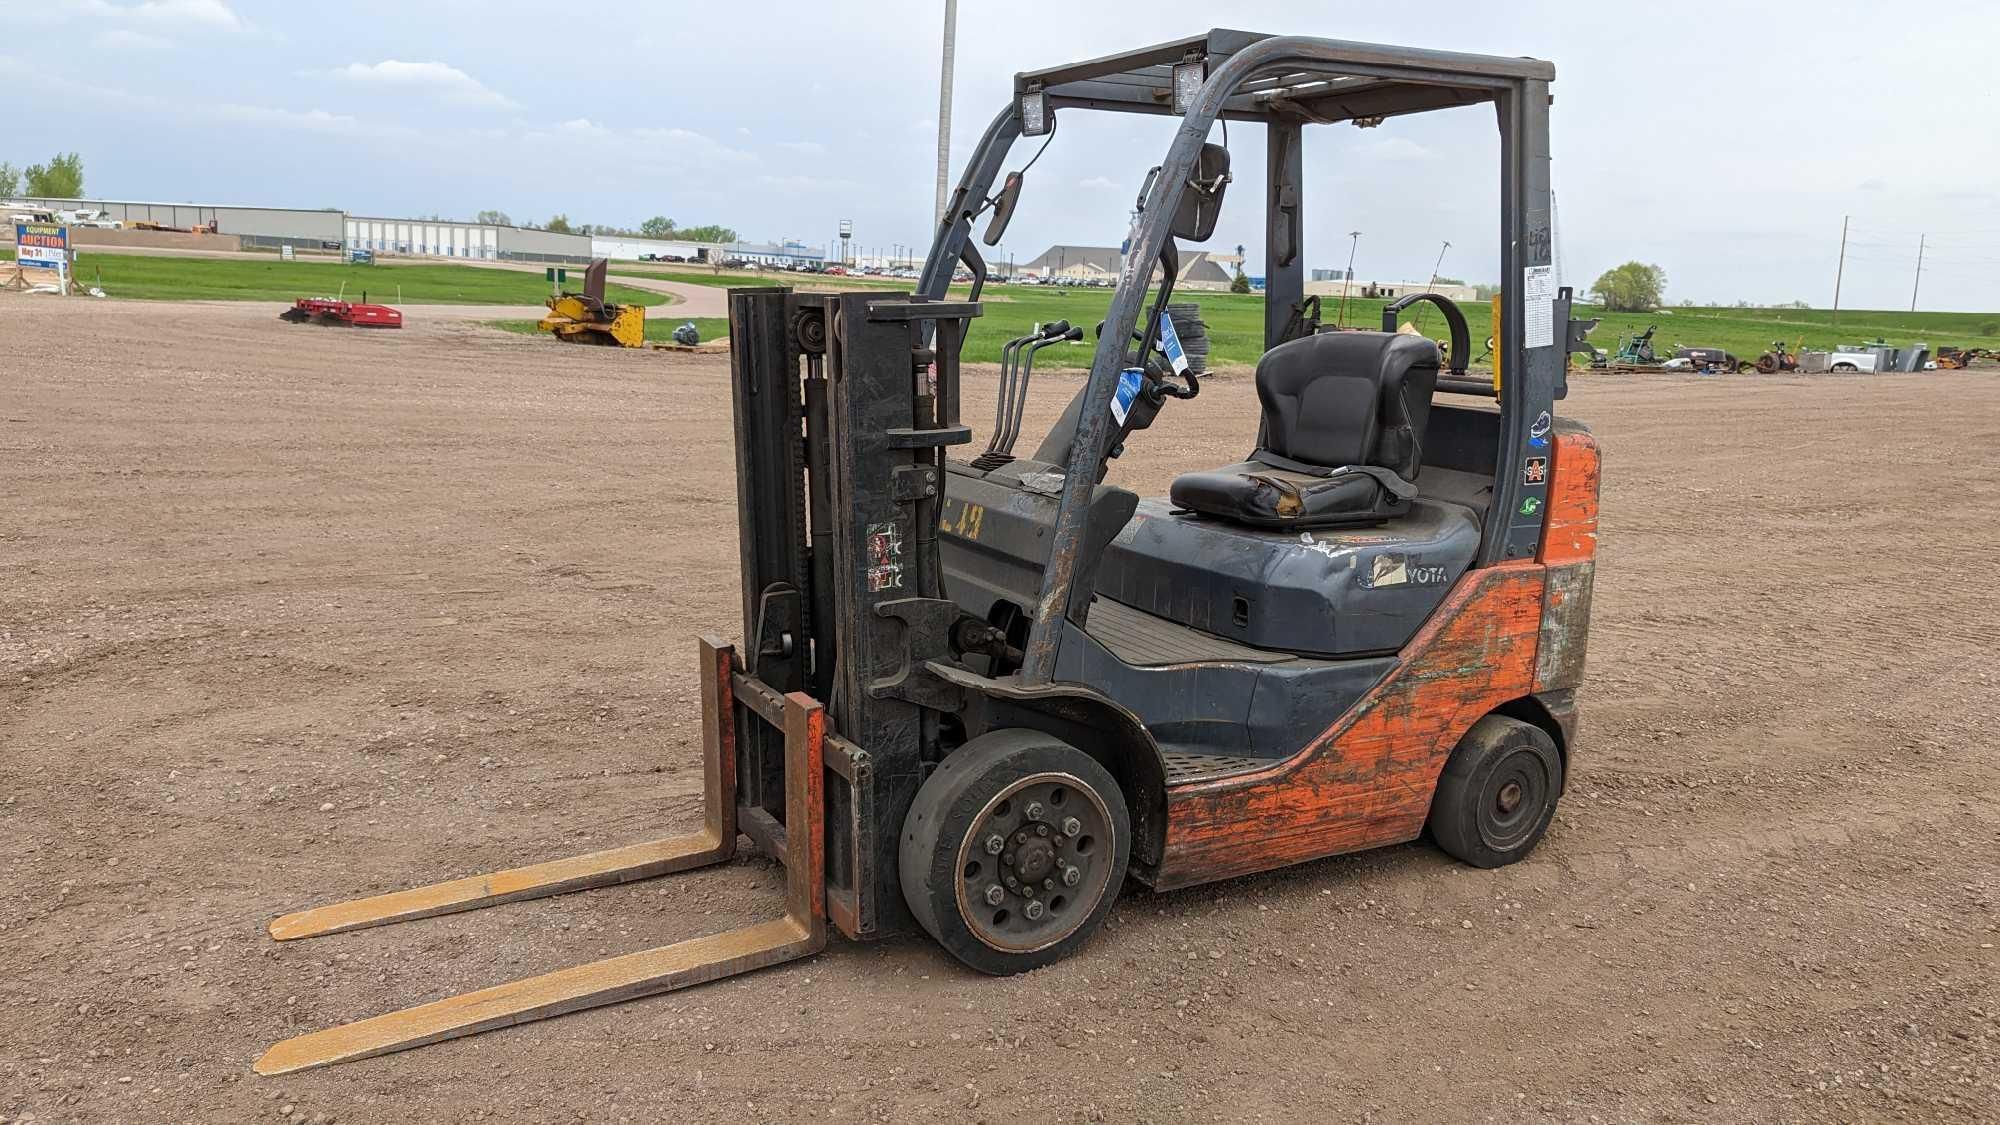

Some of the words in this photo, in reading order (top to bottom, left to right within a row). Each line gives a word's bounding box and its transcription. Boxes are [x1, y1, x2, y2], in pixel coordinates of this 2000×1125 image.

[26, 225, 59, 235] EQUIPMENT
[21, 234, 65, 248] AUCTION
[21, 247, 34, 258] May
[34, 248, 43, 257] 31
[1406, 567, 1448, 584] YOTA
